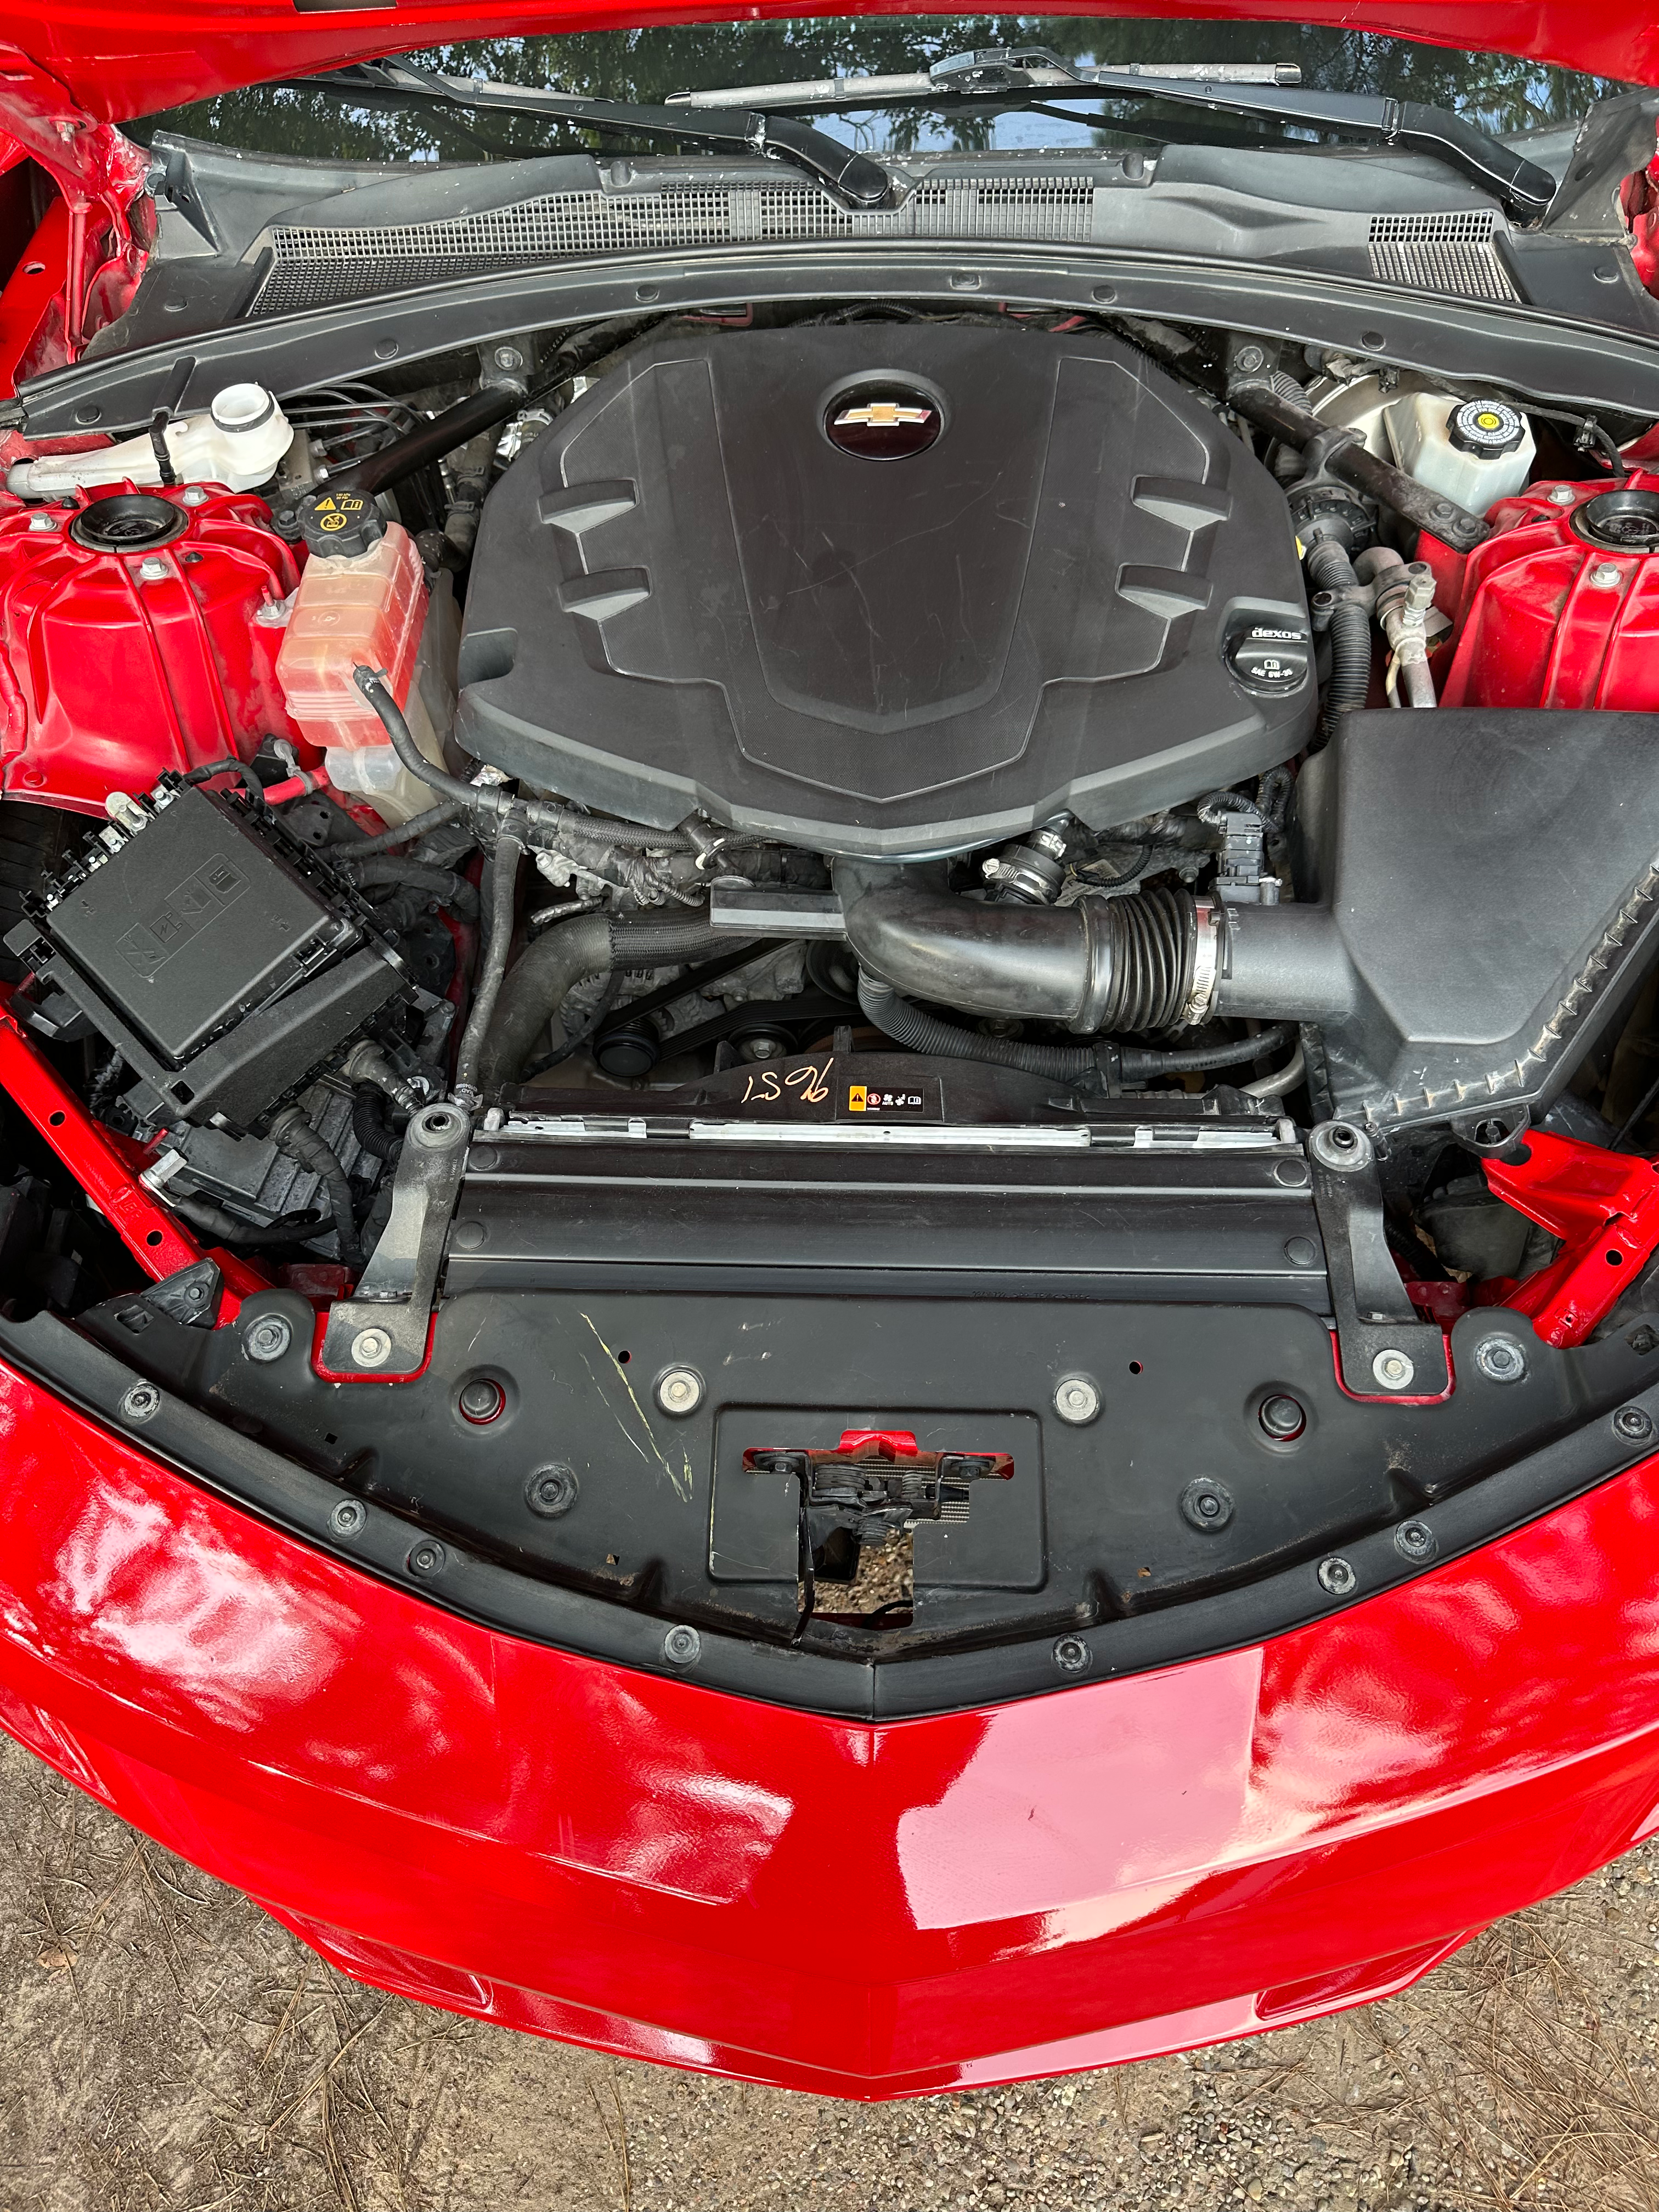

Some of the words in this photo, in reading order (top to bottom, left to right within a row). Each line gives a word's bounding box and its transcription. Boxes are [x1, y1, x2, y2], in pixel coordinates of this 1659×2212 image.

[1251, 627, 1302, 640] dexos
[1251, 667, 1265, 677] SAE
[1268, 668, 1293, 678] 5W-30
